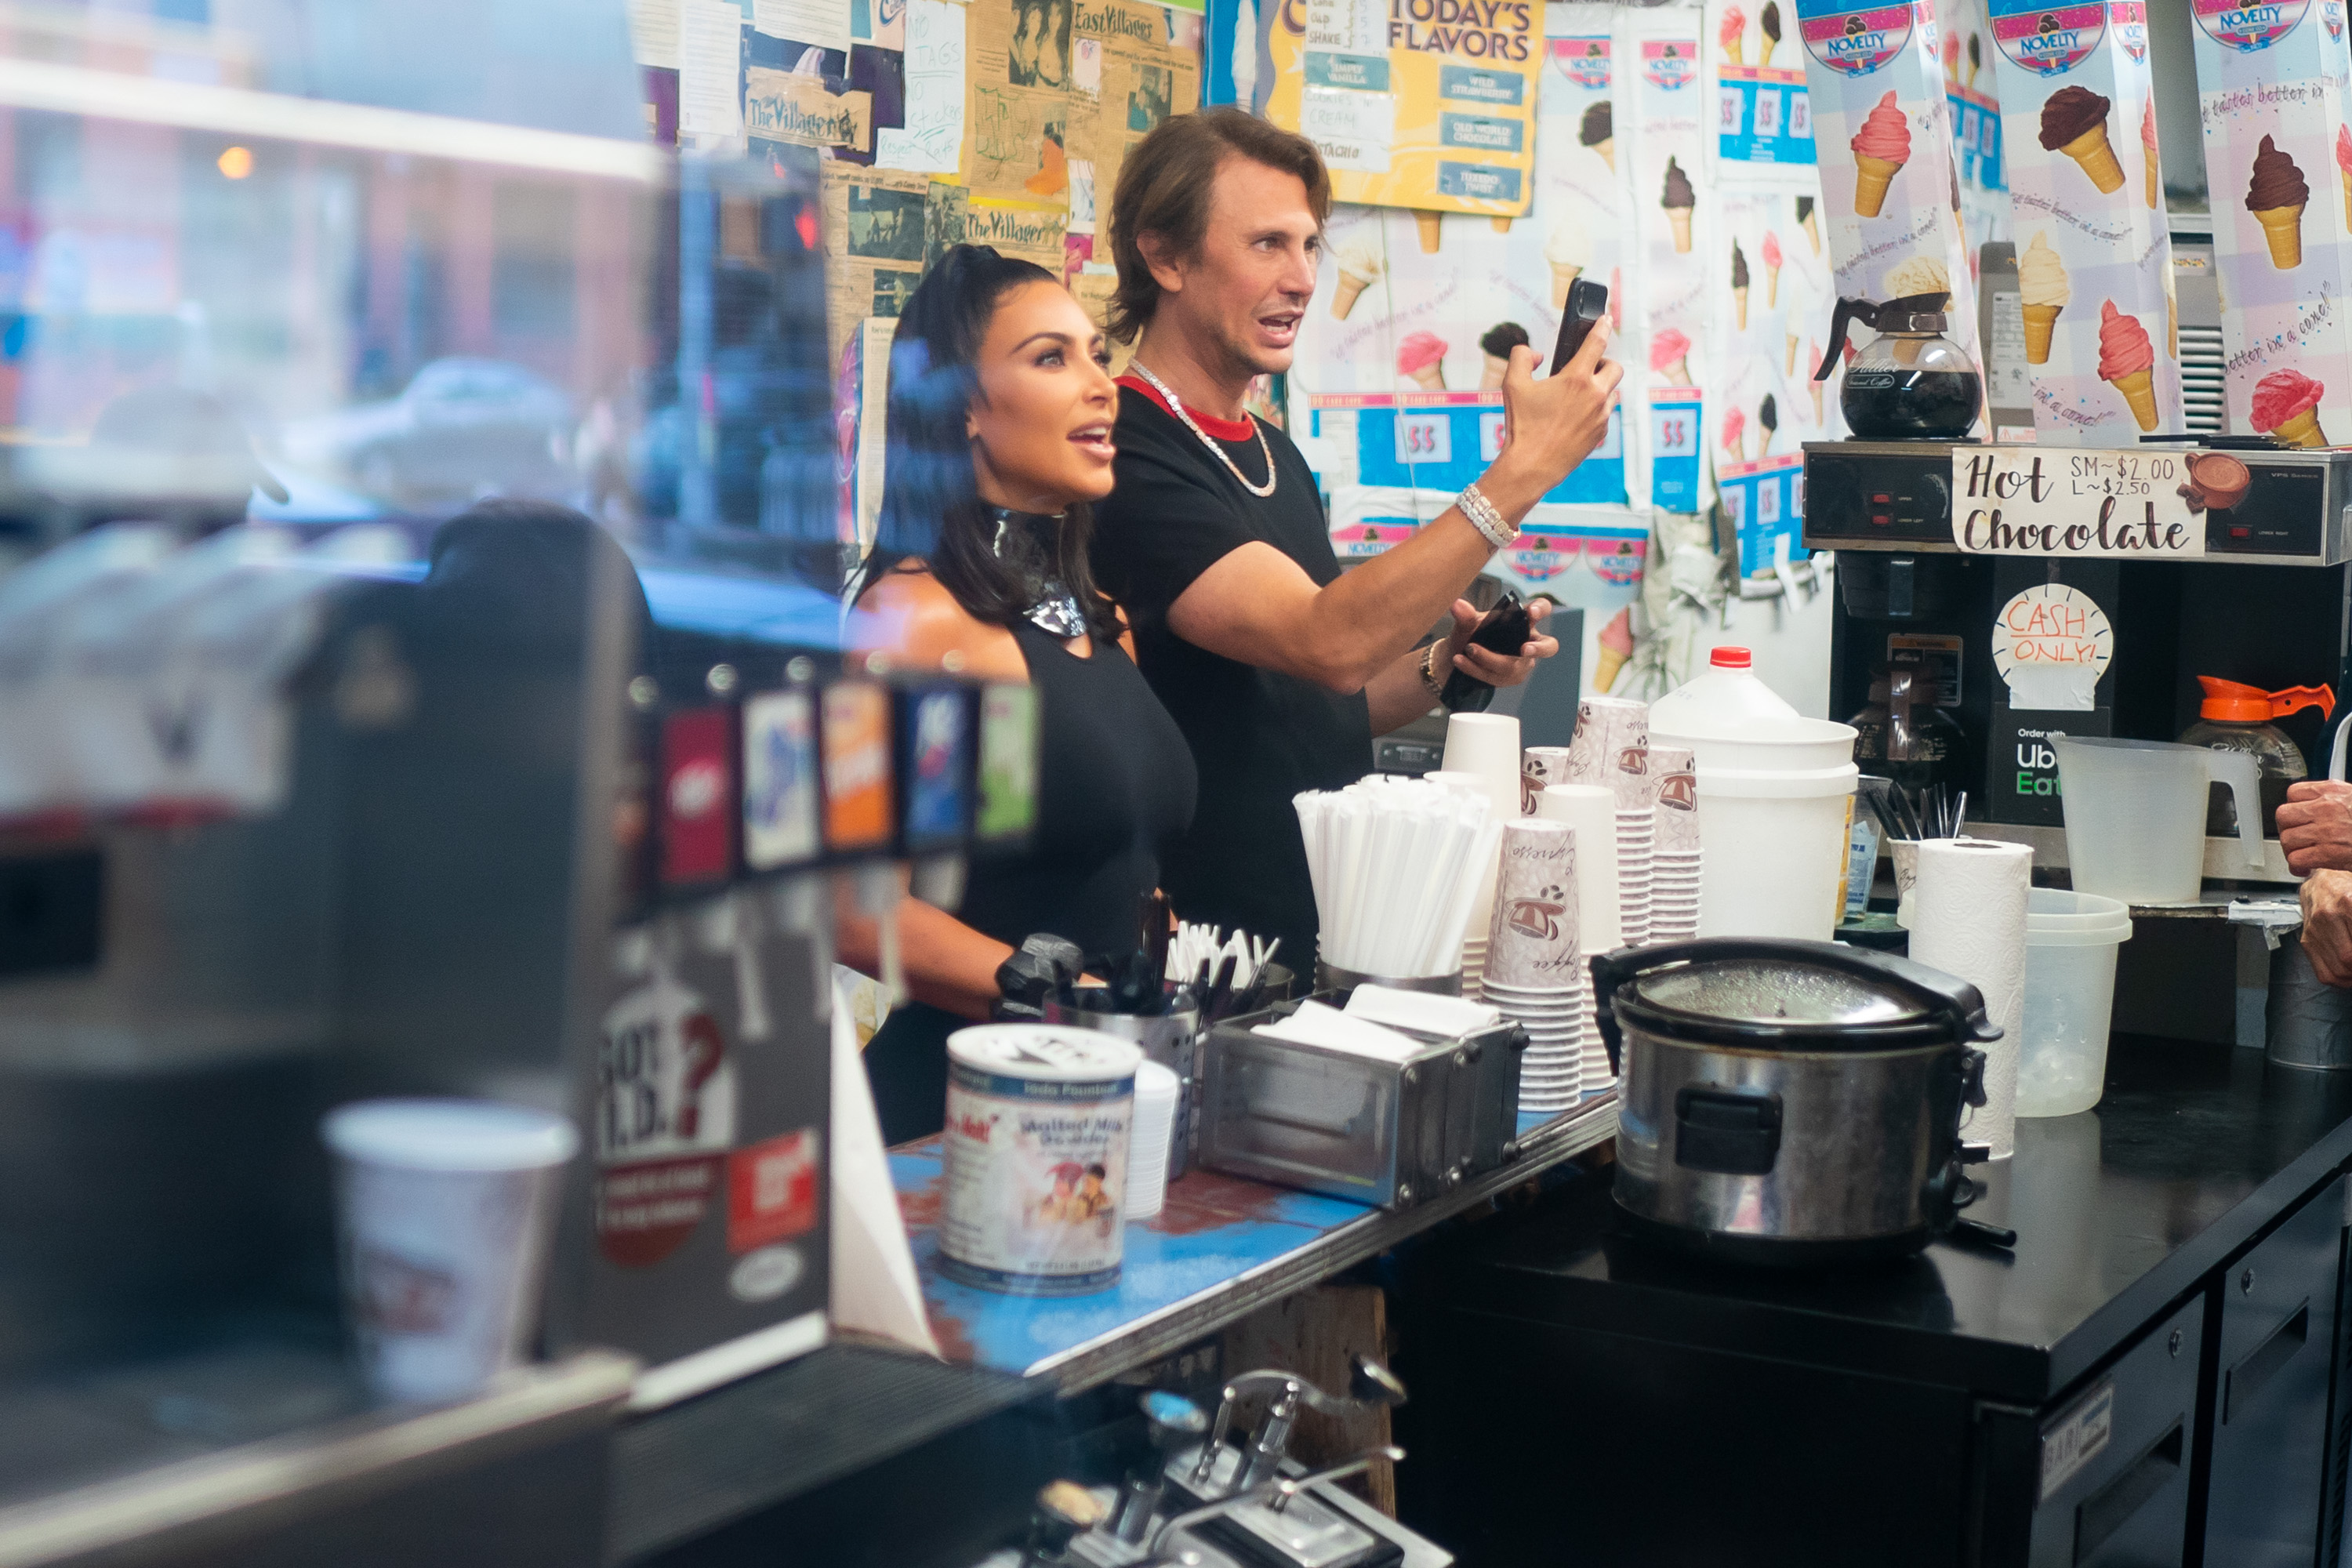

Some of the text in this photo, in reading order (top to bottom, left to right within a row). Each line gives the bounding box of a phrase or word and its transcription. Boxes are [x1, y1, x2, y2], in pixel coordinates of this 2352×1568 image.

[908, 16, 929, 38] NO
[1392, 0, 1530, 32] TODAY'S
[2220, 6, 2282, 30] NOVELTY
[1308, 31, 1341, 45] SHAKE
[1387, 21, 1529, 62] FLAVORS
[1828, 32, 1886, 56] NOVELTY
[2021, 31, 2078, 56] NOVELTY
[916, 42, 961, 67] TAGS
[1650, 60, 1689, 71] NOVELTY
[906, 82, 924, 101] NO
[1452, 85, 1512, 100] STRAWBERRY
[1469, 76, 1495, 88] WILD
[2257, 81, 2306, 103] better
[1305, 90, 1352, 106] COOKIES
[1309, 108, 1356, 128] CREAM
[1315, 140, 1360, 158] STACHIO
[1465, 182, 1494, 194] TWIST
[967, 211, 1047, 244] The Villager
[1965, 455, 2054, 503] Hot
[1964, 495, 2191, 551] Chocolate
[2007, 601, 2086, 637] CASH
[2014, 640, 2097, 664] ONLY!
[2018, 728, 2066, 739] Order with
[2016, 742, 2057, 769] Ub
[2016, 771, 2063, 795] Eat
